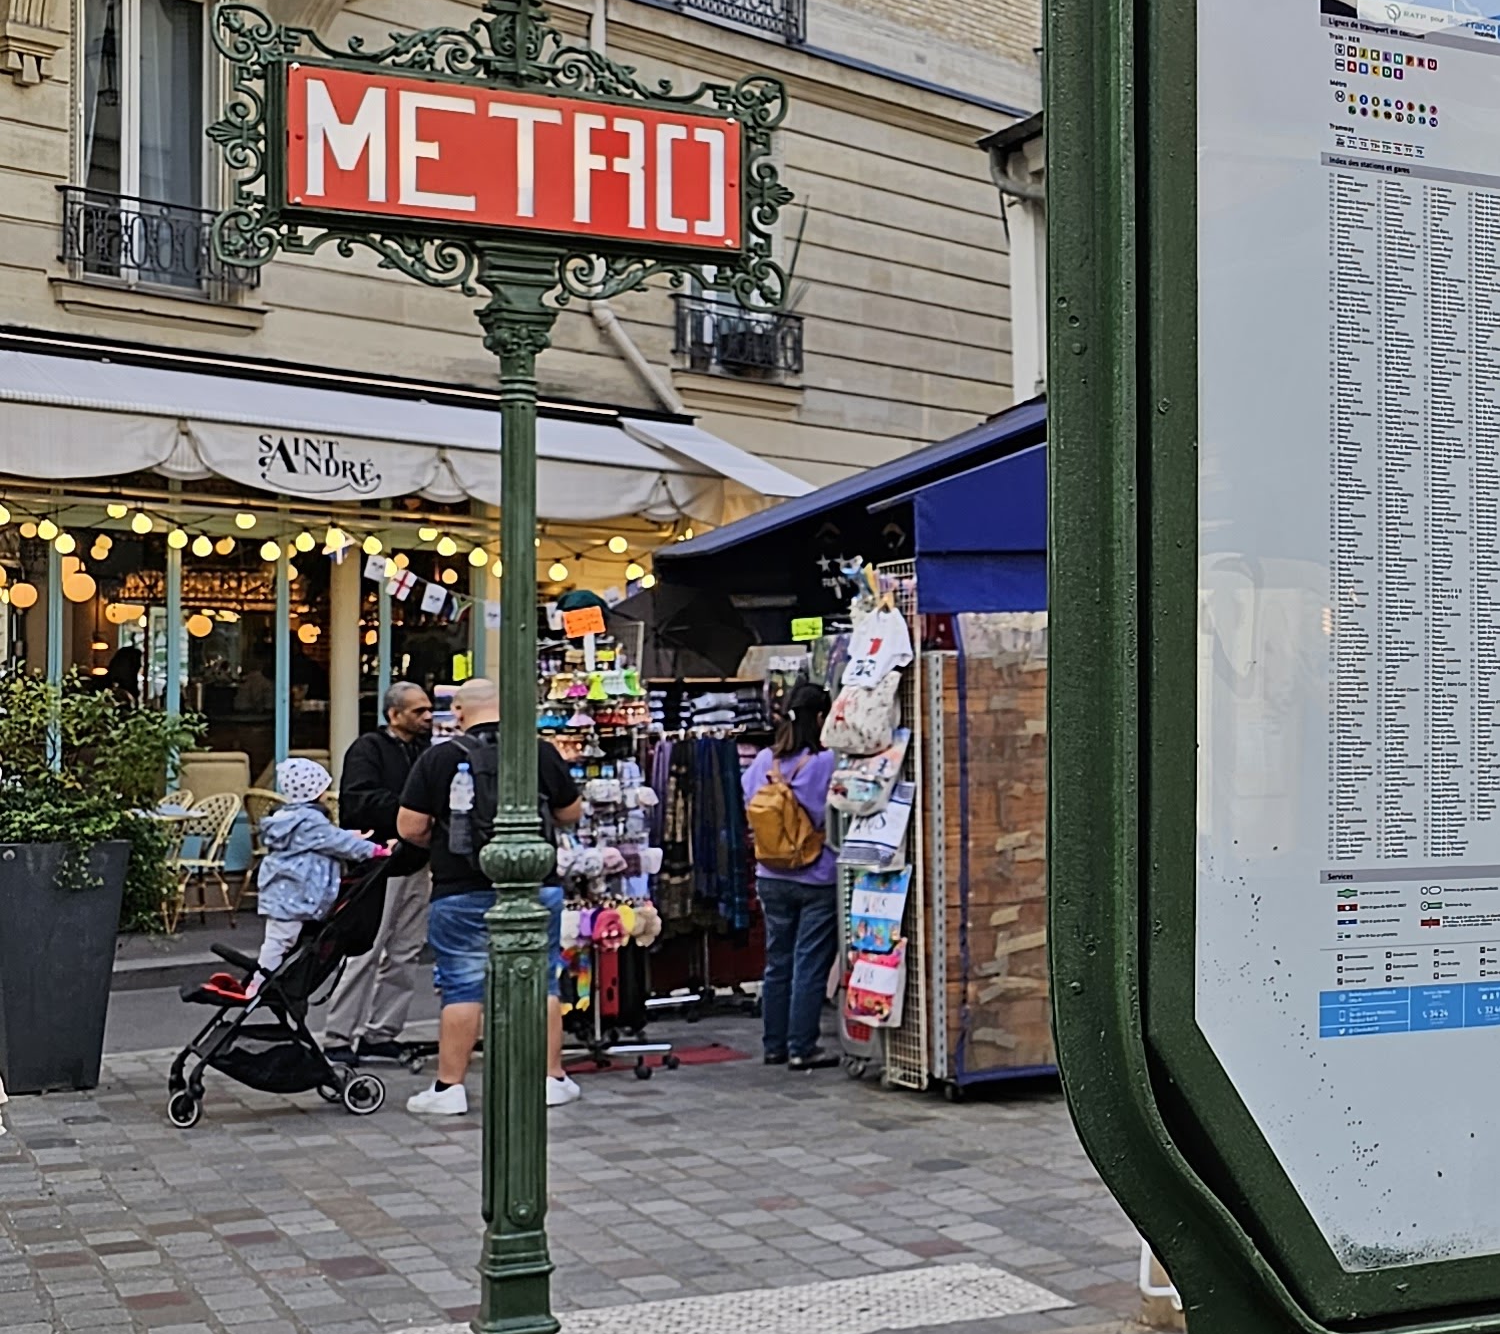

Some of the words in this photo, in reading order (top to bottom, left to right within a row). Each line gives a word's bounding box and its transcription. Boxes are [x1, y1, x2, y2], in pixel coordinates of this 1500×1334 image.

[1328, 17, 1350, 29] Lignes
[1350, 20, 1359, 29] de
[1359, 22, 1389, 35] transport
[1389, 28, 1399, 36] en
[305, 77, 725, 237] METRO
[1329, 156, 1348, 167] Index
[1348, 159, 1360, 168] des
[1360, 161, 1386, 172] stations
[1394, 165, 1411, 175] gares
[1327, 872, 1354, 881] Services
